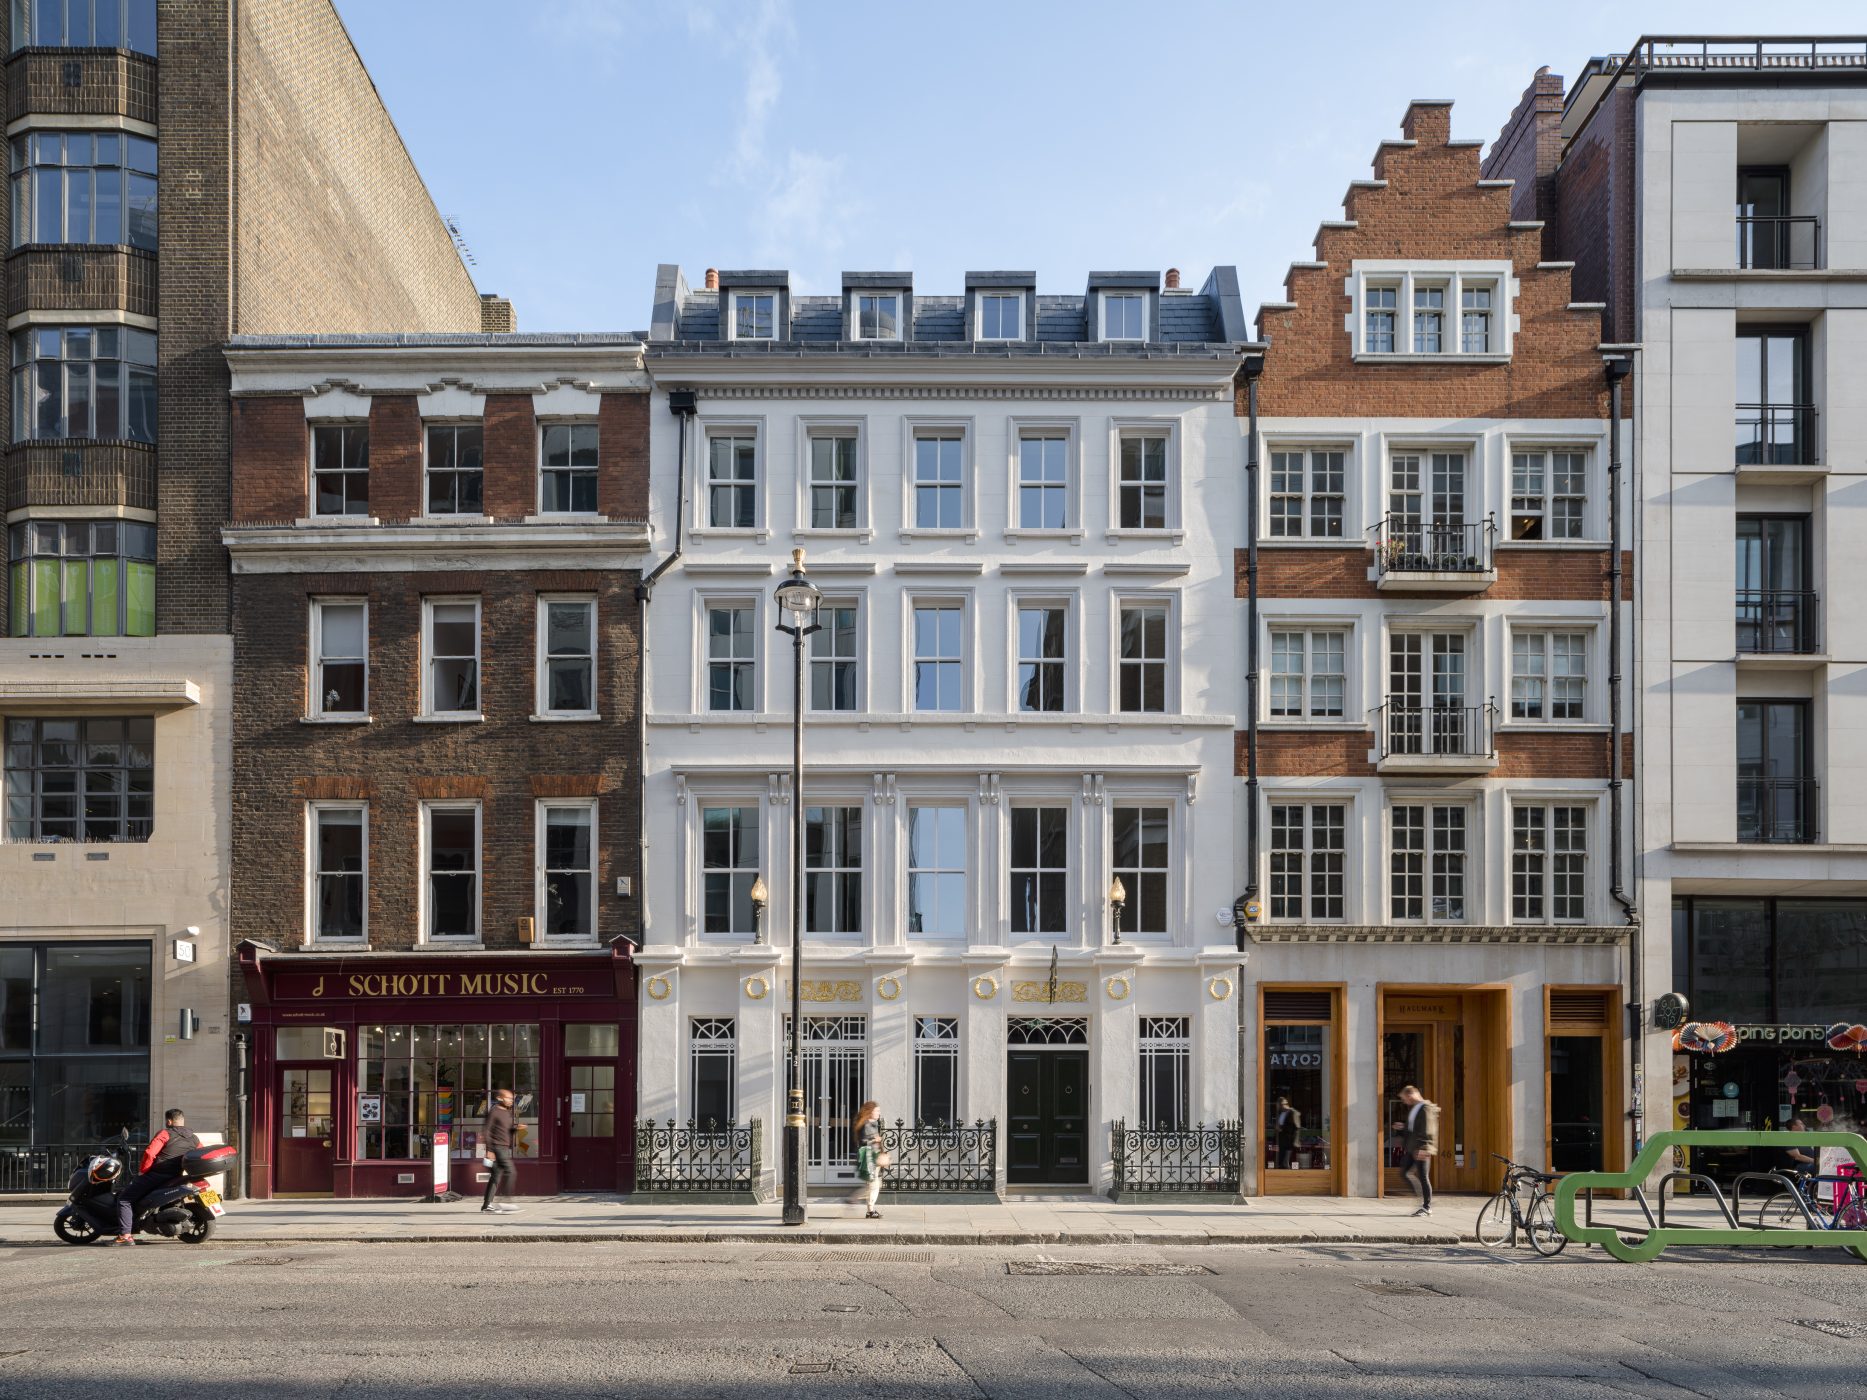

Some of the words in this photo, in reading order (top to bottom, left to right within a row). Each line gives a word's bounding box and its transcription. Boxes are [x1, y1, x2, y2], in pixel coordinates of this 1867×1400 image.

[178, 944, 191, 958] 50
[348, 973, 451, 996] SCHOTT
[459, 972, 548, 995] MUSIC
[569, 986, 584, 994] 1770
